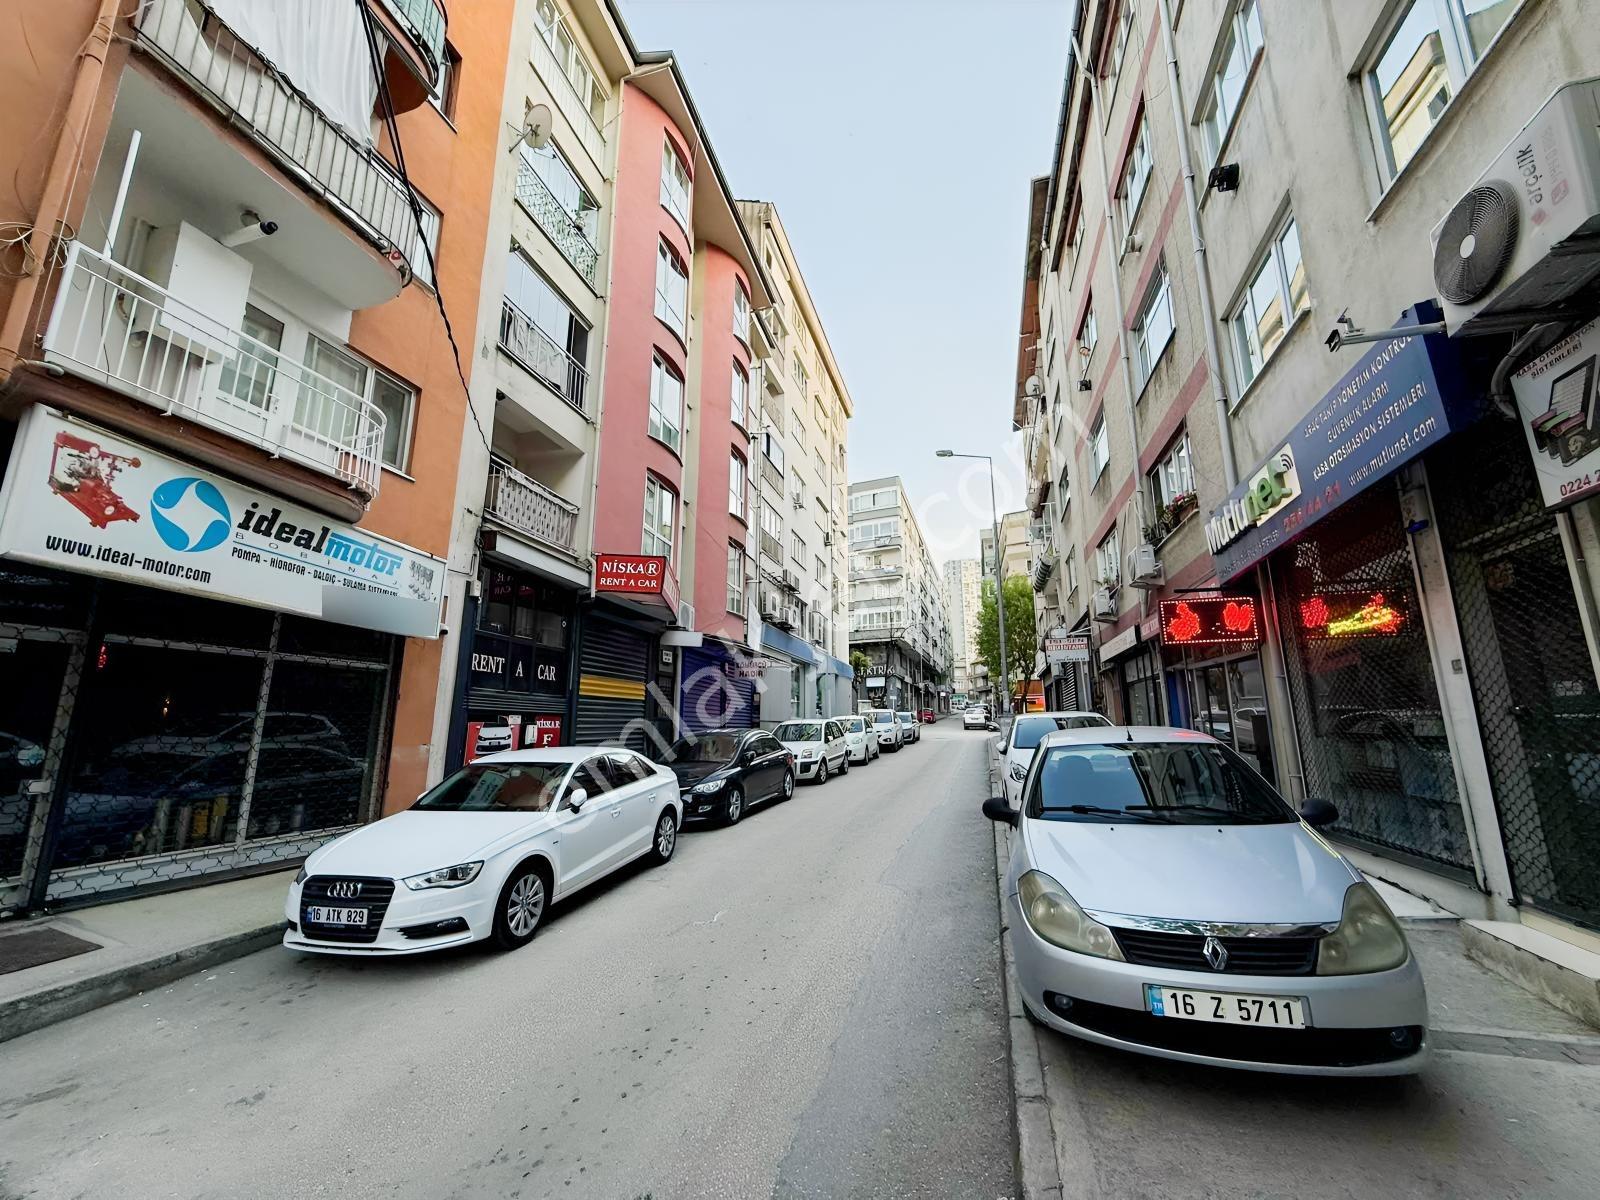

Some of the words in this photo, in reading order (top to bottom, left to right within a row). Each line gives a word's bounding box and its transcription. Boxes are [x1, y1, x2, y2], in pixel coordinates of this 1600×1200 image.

[1362, 381, 1389, 412] ALARM
[1560, 473, 1591, 496] 0224
[46, 535, 211, 584] www.ideal-motor.com
[232, 546, 261, 563] POMPA
[600, 577, 627, 586] RENT
[471, 653, 505, 674] RENT
[515, 660, 524, 677] A
[537, 664, 556, 681] CAR
[312, 907, 321, 920] 16
[326, 908, 342, 922] ATK
[347, 909, 364, 923] 829
[1170, 992, 1195, 1016] 16
[1210, 996, 1225, 1019] Z
[1237, 998, 1294, 1025] 5711
